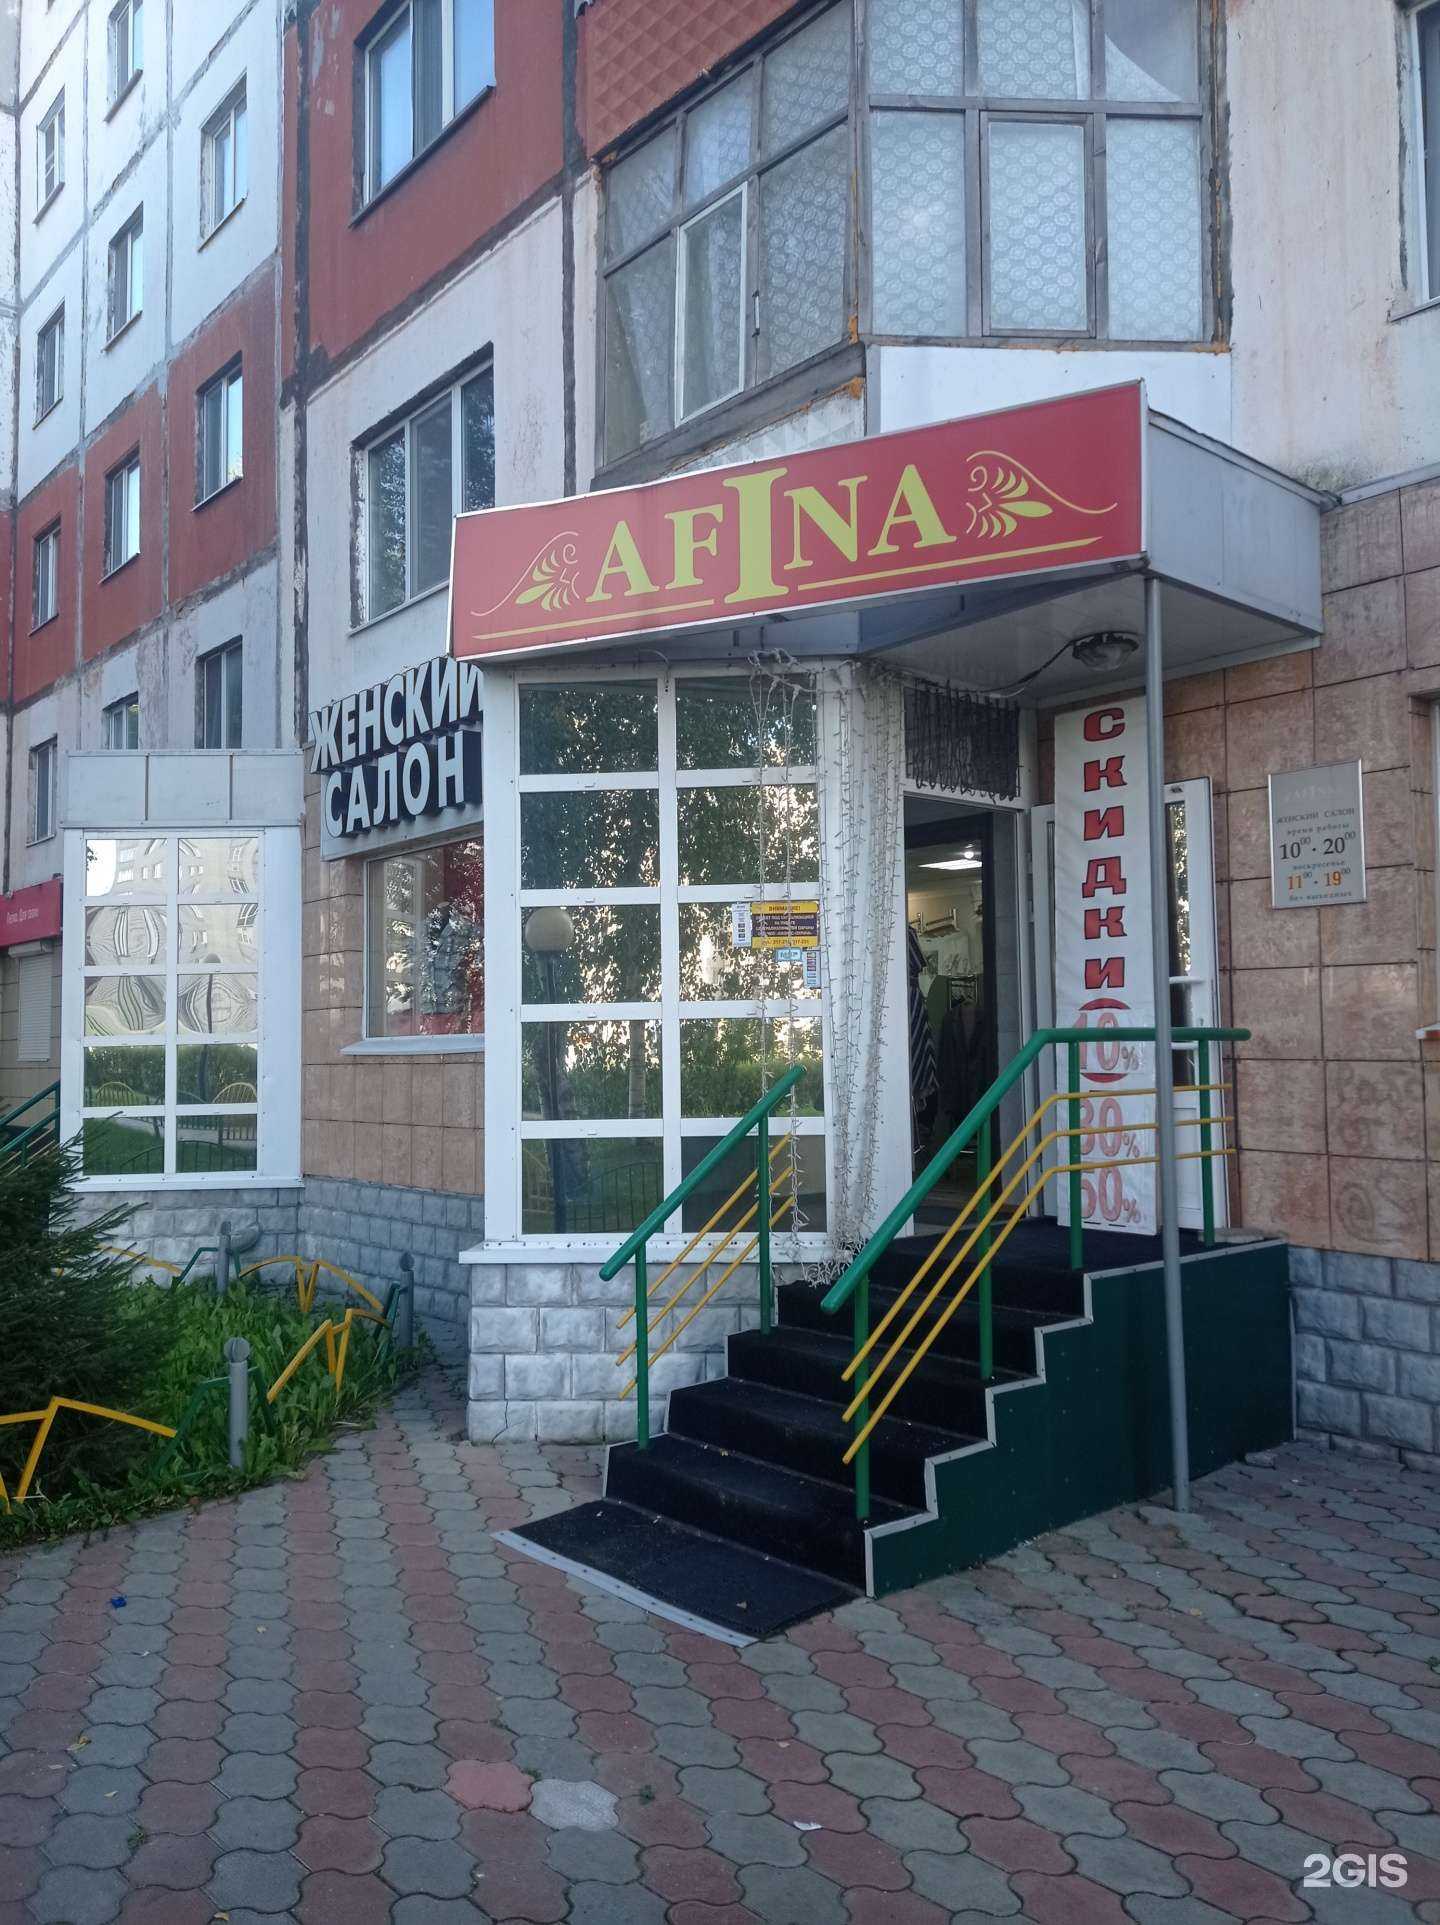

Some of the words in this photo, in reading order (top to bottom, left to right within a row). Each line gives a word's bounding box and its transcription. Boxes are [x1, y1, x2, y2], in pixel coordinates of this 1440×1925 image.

[585, 464, 956, 603] AFINA
[325, 731, 465, 838] САЛОН
[1082, 707, 1127, 990] СКИДКИ
